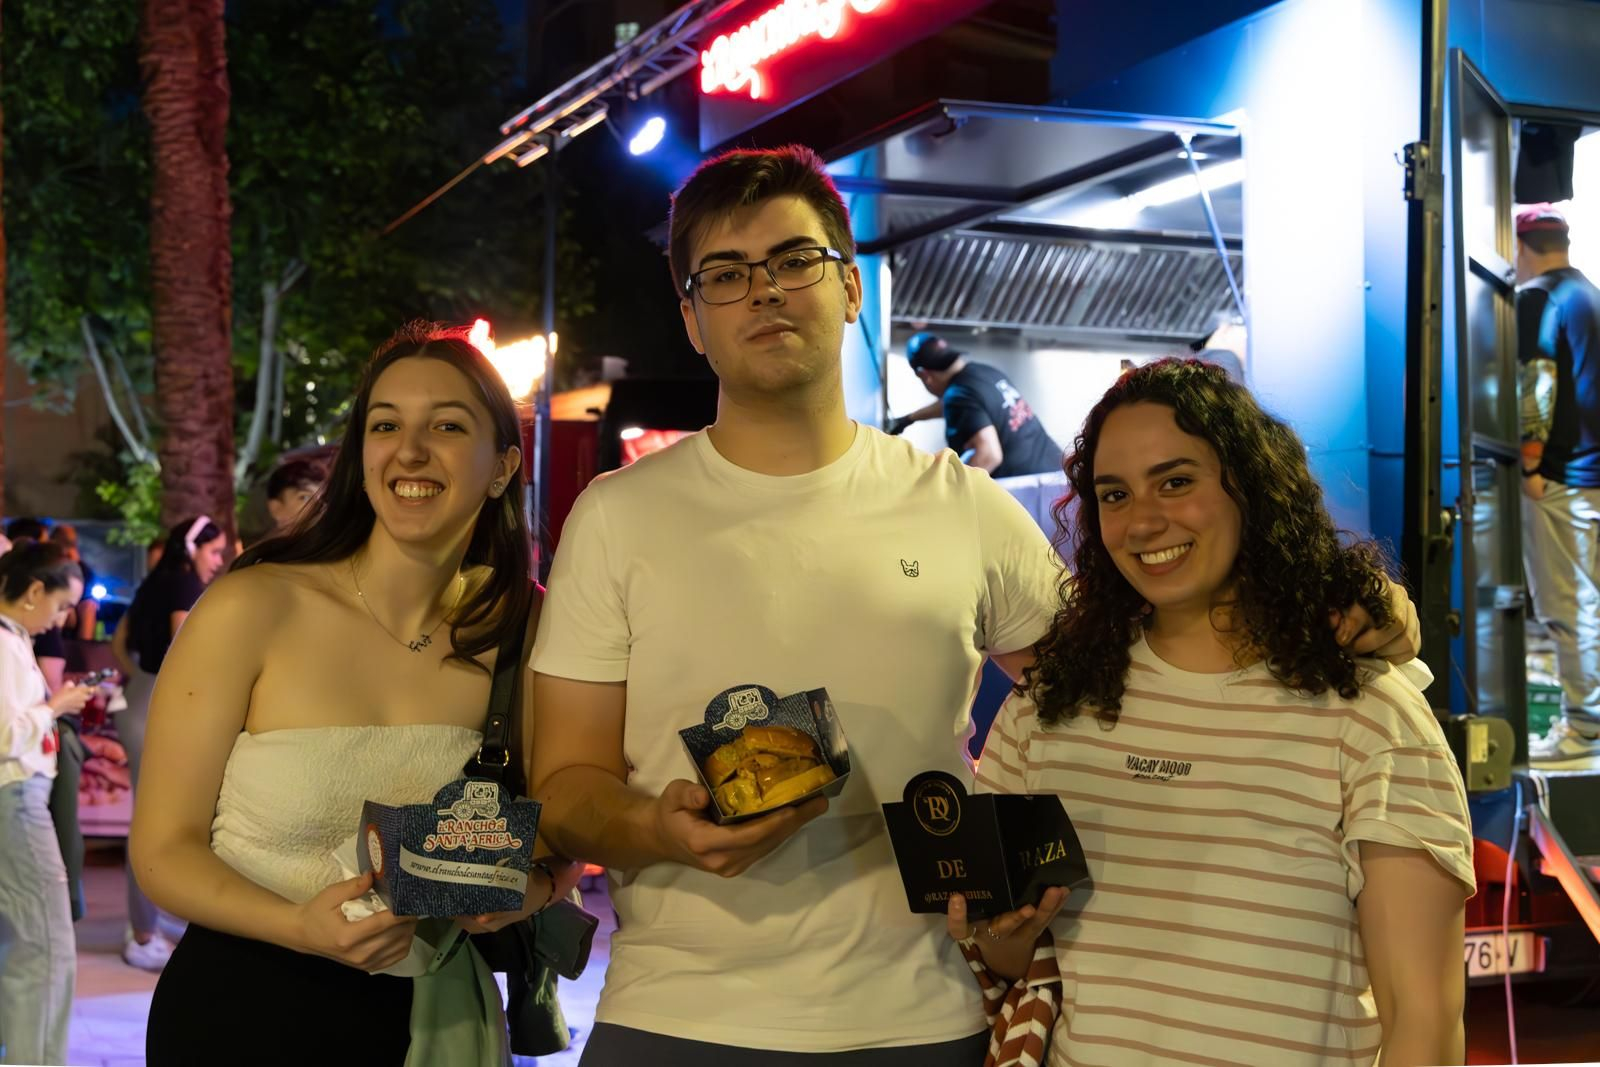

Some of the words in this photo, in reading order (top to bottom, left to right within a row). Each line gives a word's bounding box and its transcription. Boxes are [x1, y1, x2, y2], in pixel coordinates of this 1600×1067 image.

[1126, 755, 1160, 774] VACAY
[1158, 760, 1192, 776] MOOD
[447, 819, 496, 834] RANCHO
[424, 834, 467, 850] SANTA
[936, 859, 967, 879] DE
